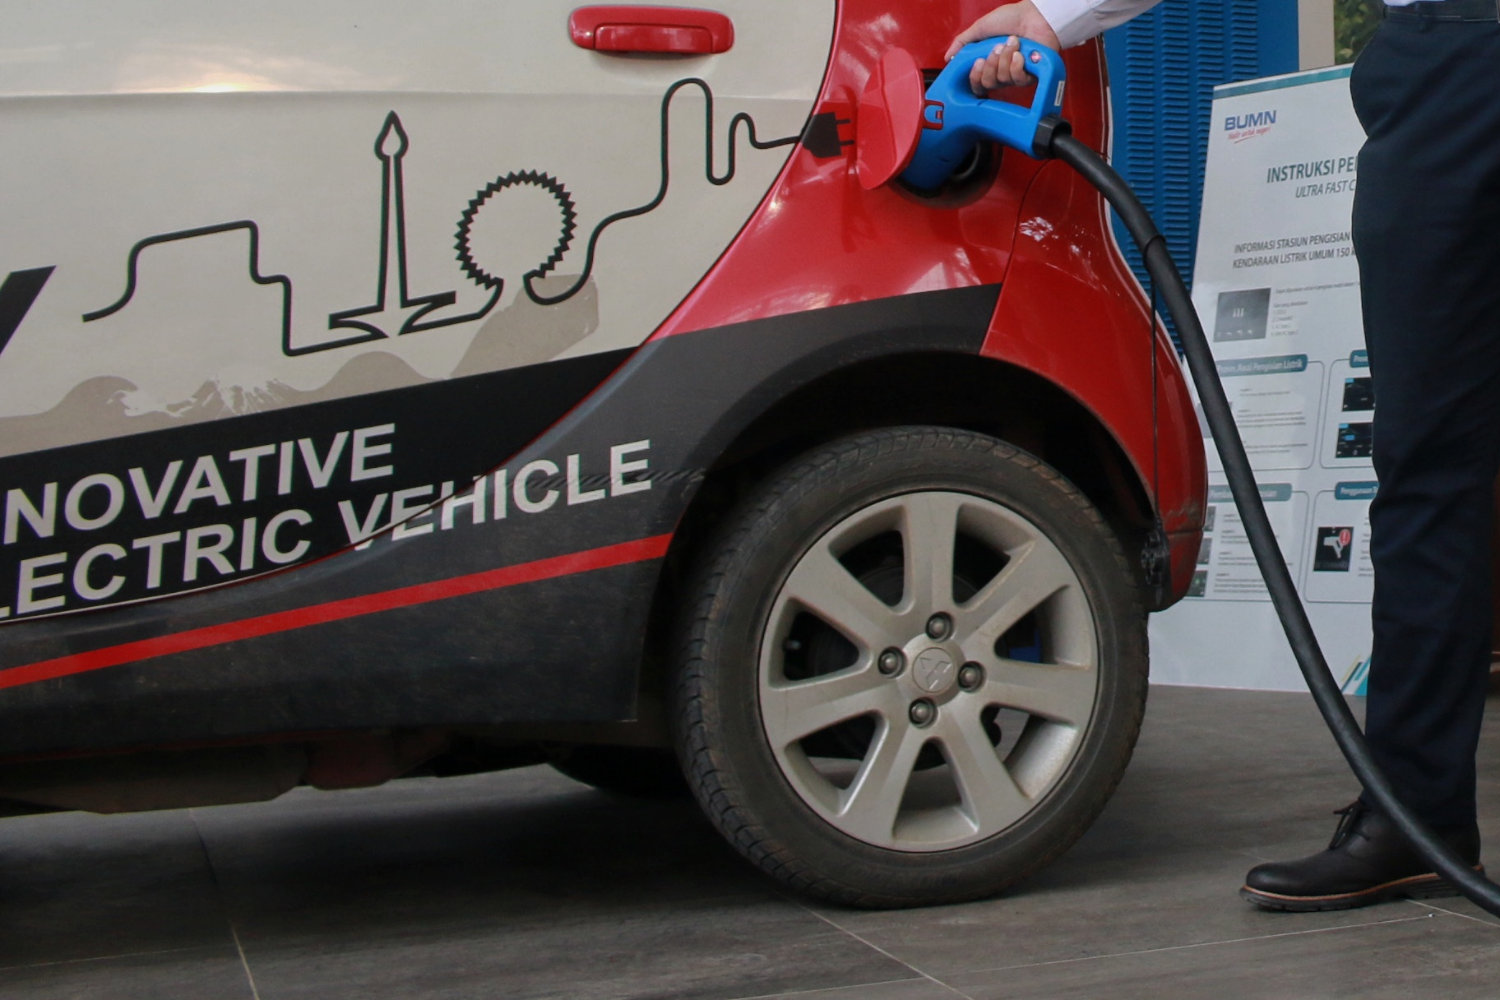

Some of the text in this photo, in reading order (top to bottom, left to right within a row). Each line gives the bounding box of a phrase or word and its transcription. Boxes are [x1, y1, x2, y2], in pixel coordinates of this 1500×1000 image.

[1224, 109, 1277, 131] BUMN
[1266, 159, 1335, 183] INSTRUKSI
[1295, 183, 1323, 198] ULTRA
[1325, 180, 1349, 194] FAST
[1234, 231, 1350, 254] INFORMASI STASIUN PENGISIAN
[1232, 255, 1279, 269] KENDARAAN
[1280, 251, 1307, 264] LISTRIK
[1309, 248, 1334, 261] UMUM
[1336, 247, 1350, 257] 150
[3, 423, 396, 545] NOVATIVE
[0, 439, 653, 619] ECTRIC VEHICLE
